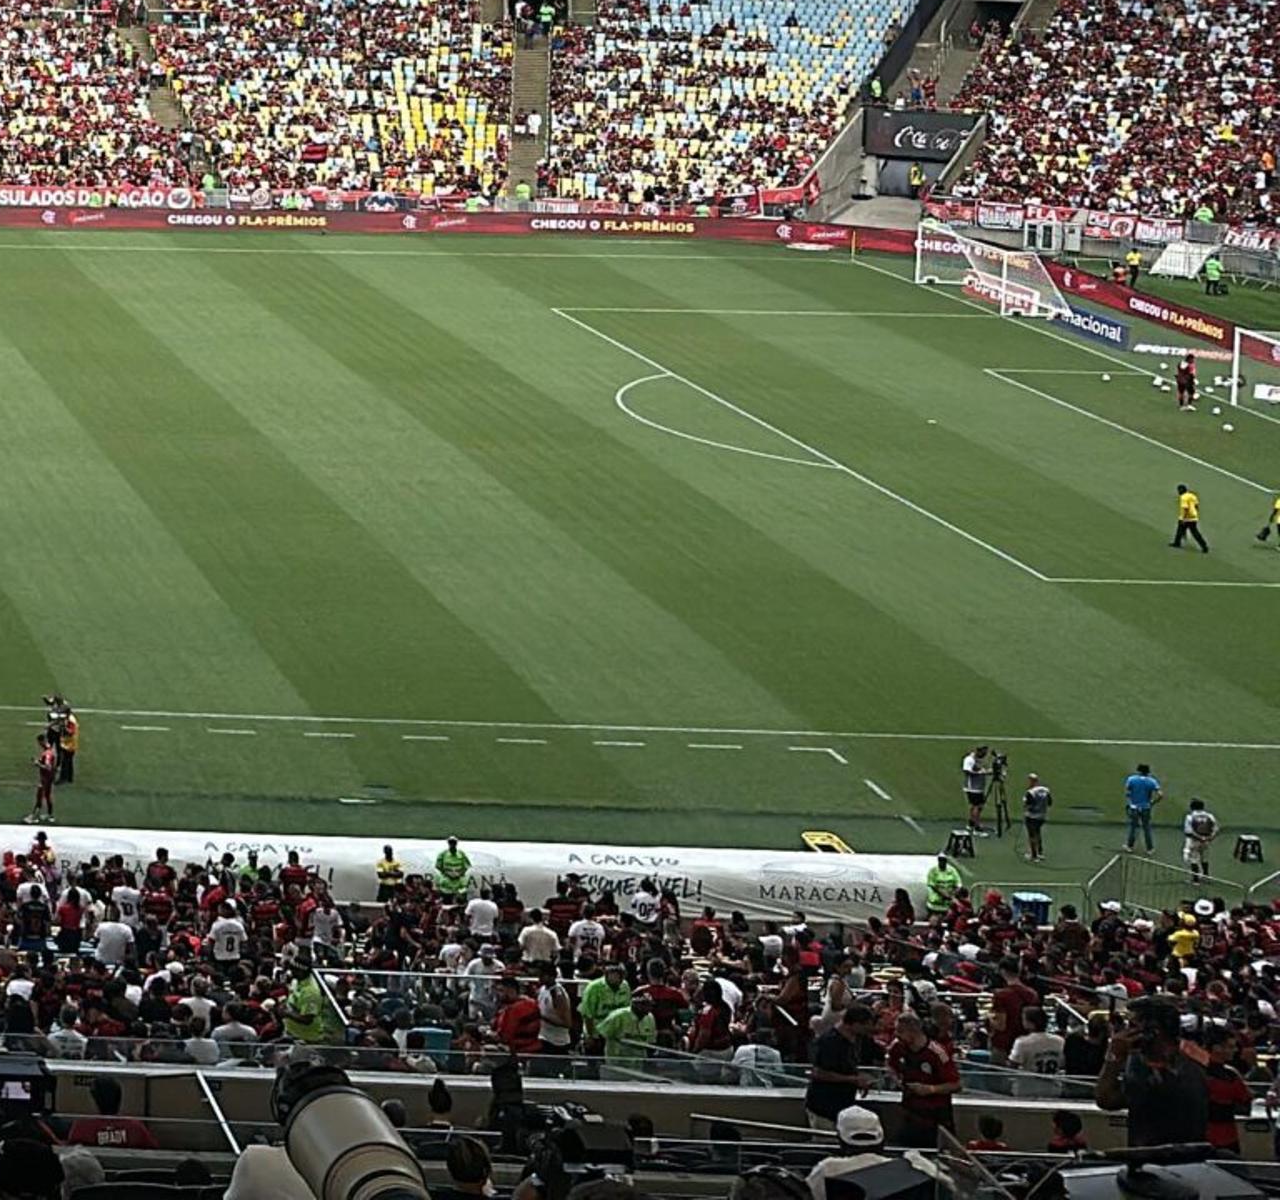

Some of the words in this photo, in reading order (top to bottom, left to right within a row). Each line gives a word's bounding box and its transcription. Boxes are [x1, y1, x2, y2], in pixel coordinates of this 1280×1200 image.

[167, 214, 223, 225] CHEGOU
[531, 218, 587, 231] CHEGOU
[759, 884, 883, 904] MARACANÃ
